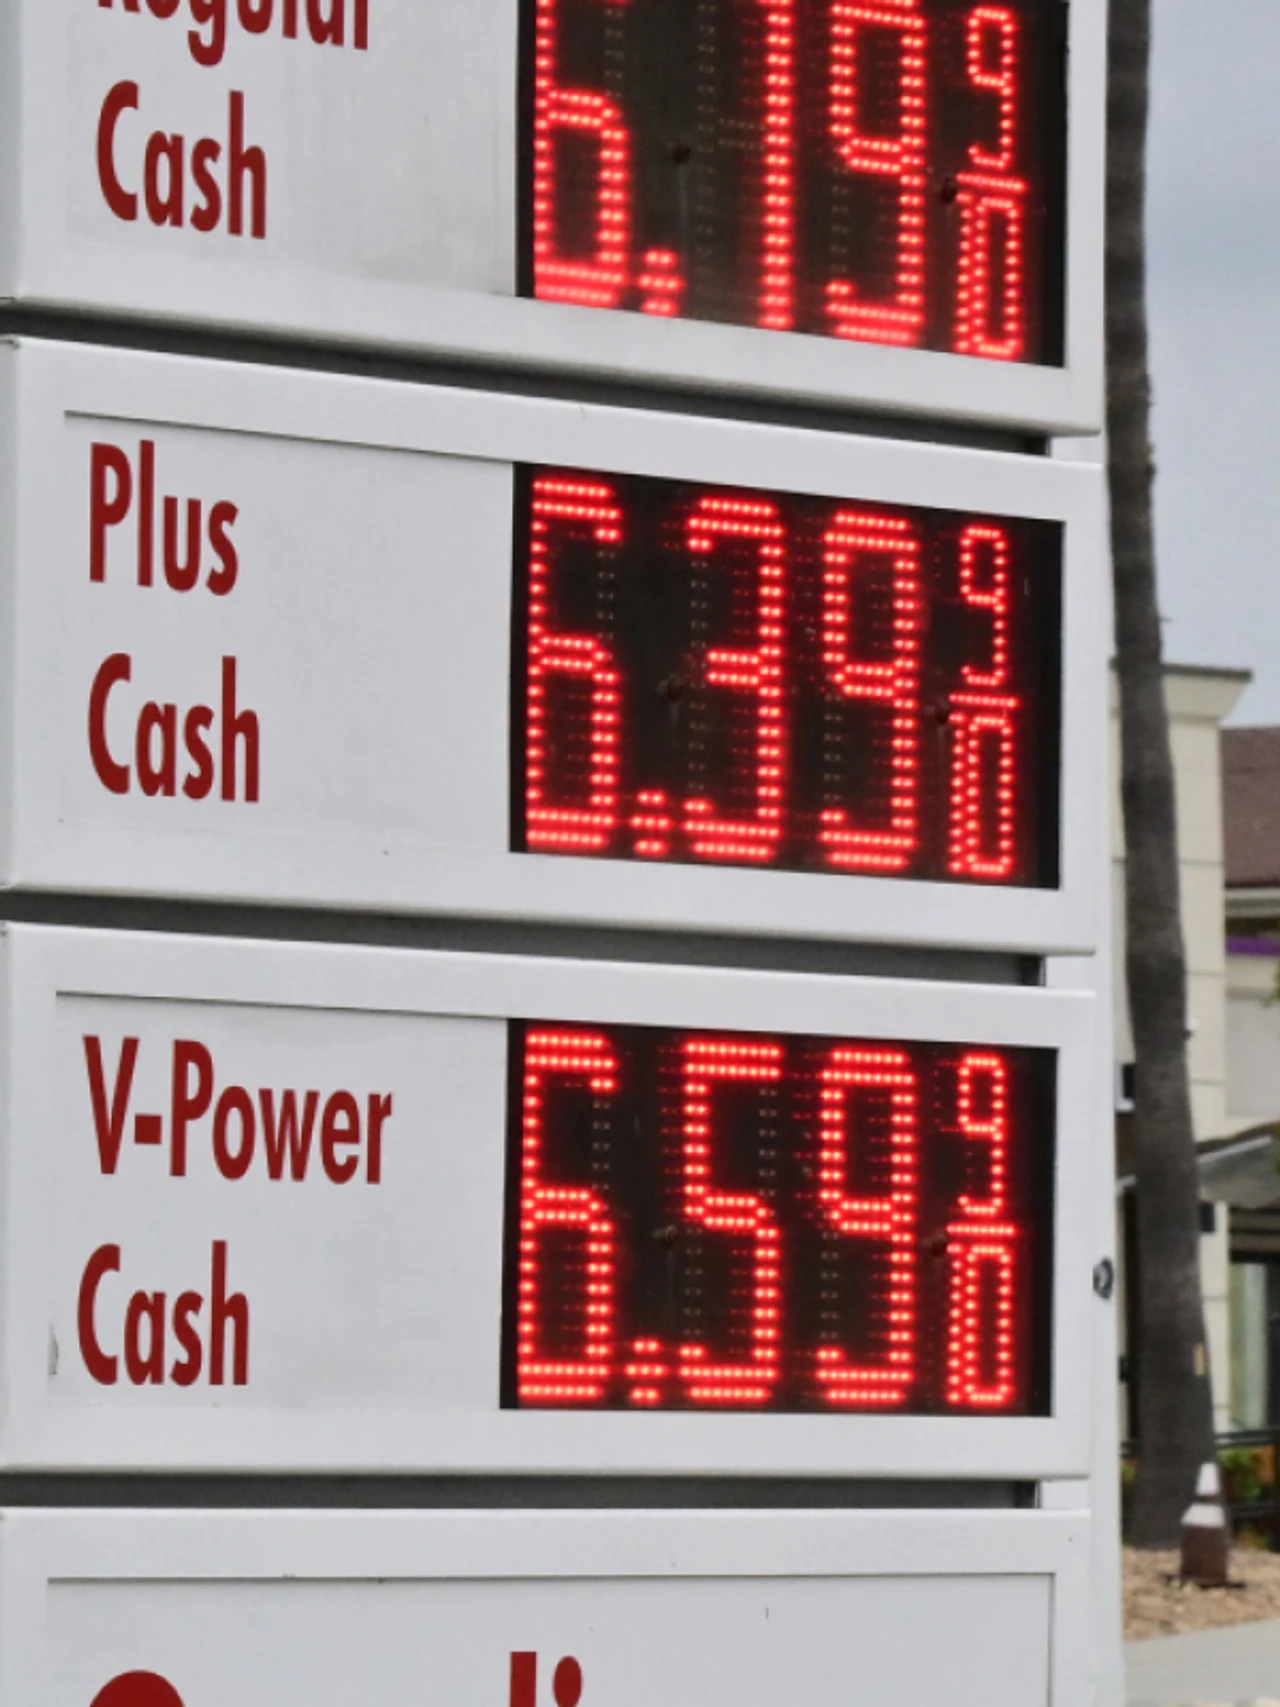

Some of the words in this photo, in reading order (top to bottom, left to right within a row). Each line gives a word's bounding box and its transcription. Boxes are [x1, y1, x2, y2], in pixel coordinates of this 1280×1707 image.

[96, 80, 267, 239] Cash
[90, 440, 239, 596] Plus
[88, 653, 260, 803] Cash
[525, 479, 918, 869] 6.39
[83, 1035, 393, 1184] V-Power
[516, 1032, 916, 1405] 6.59
[77, 1240, 249, 1386] Cash
